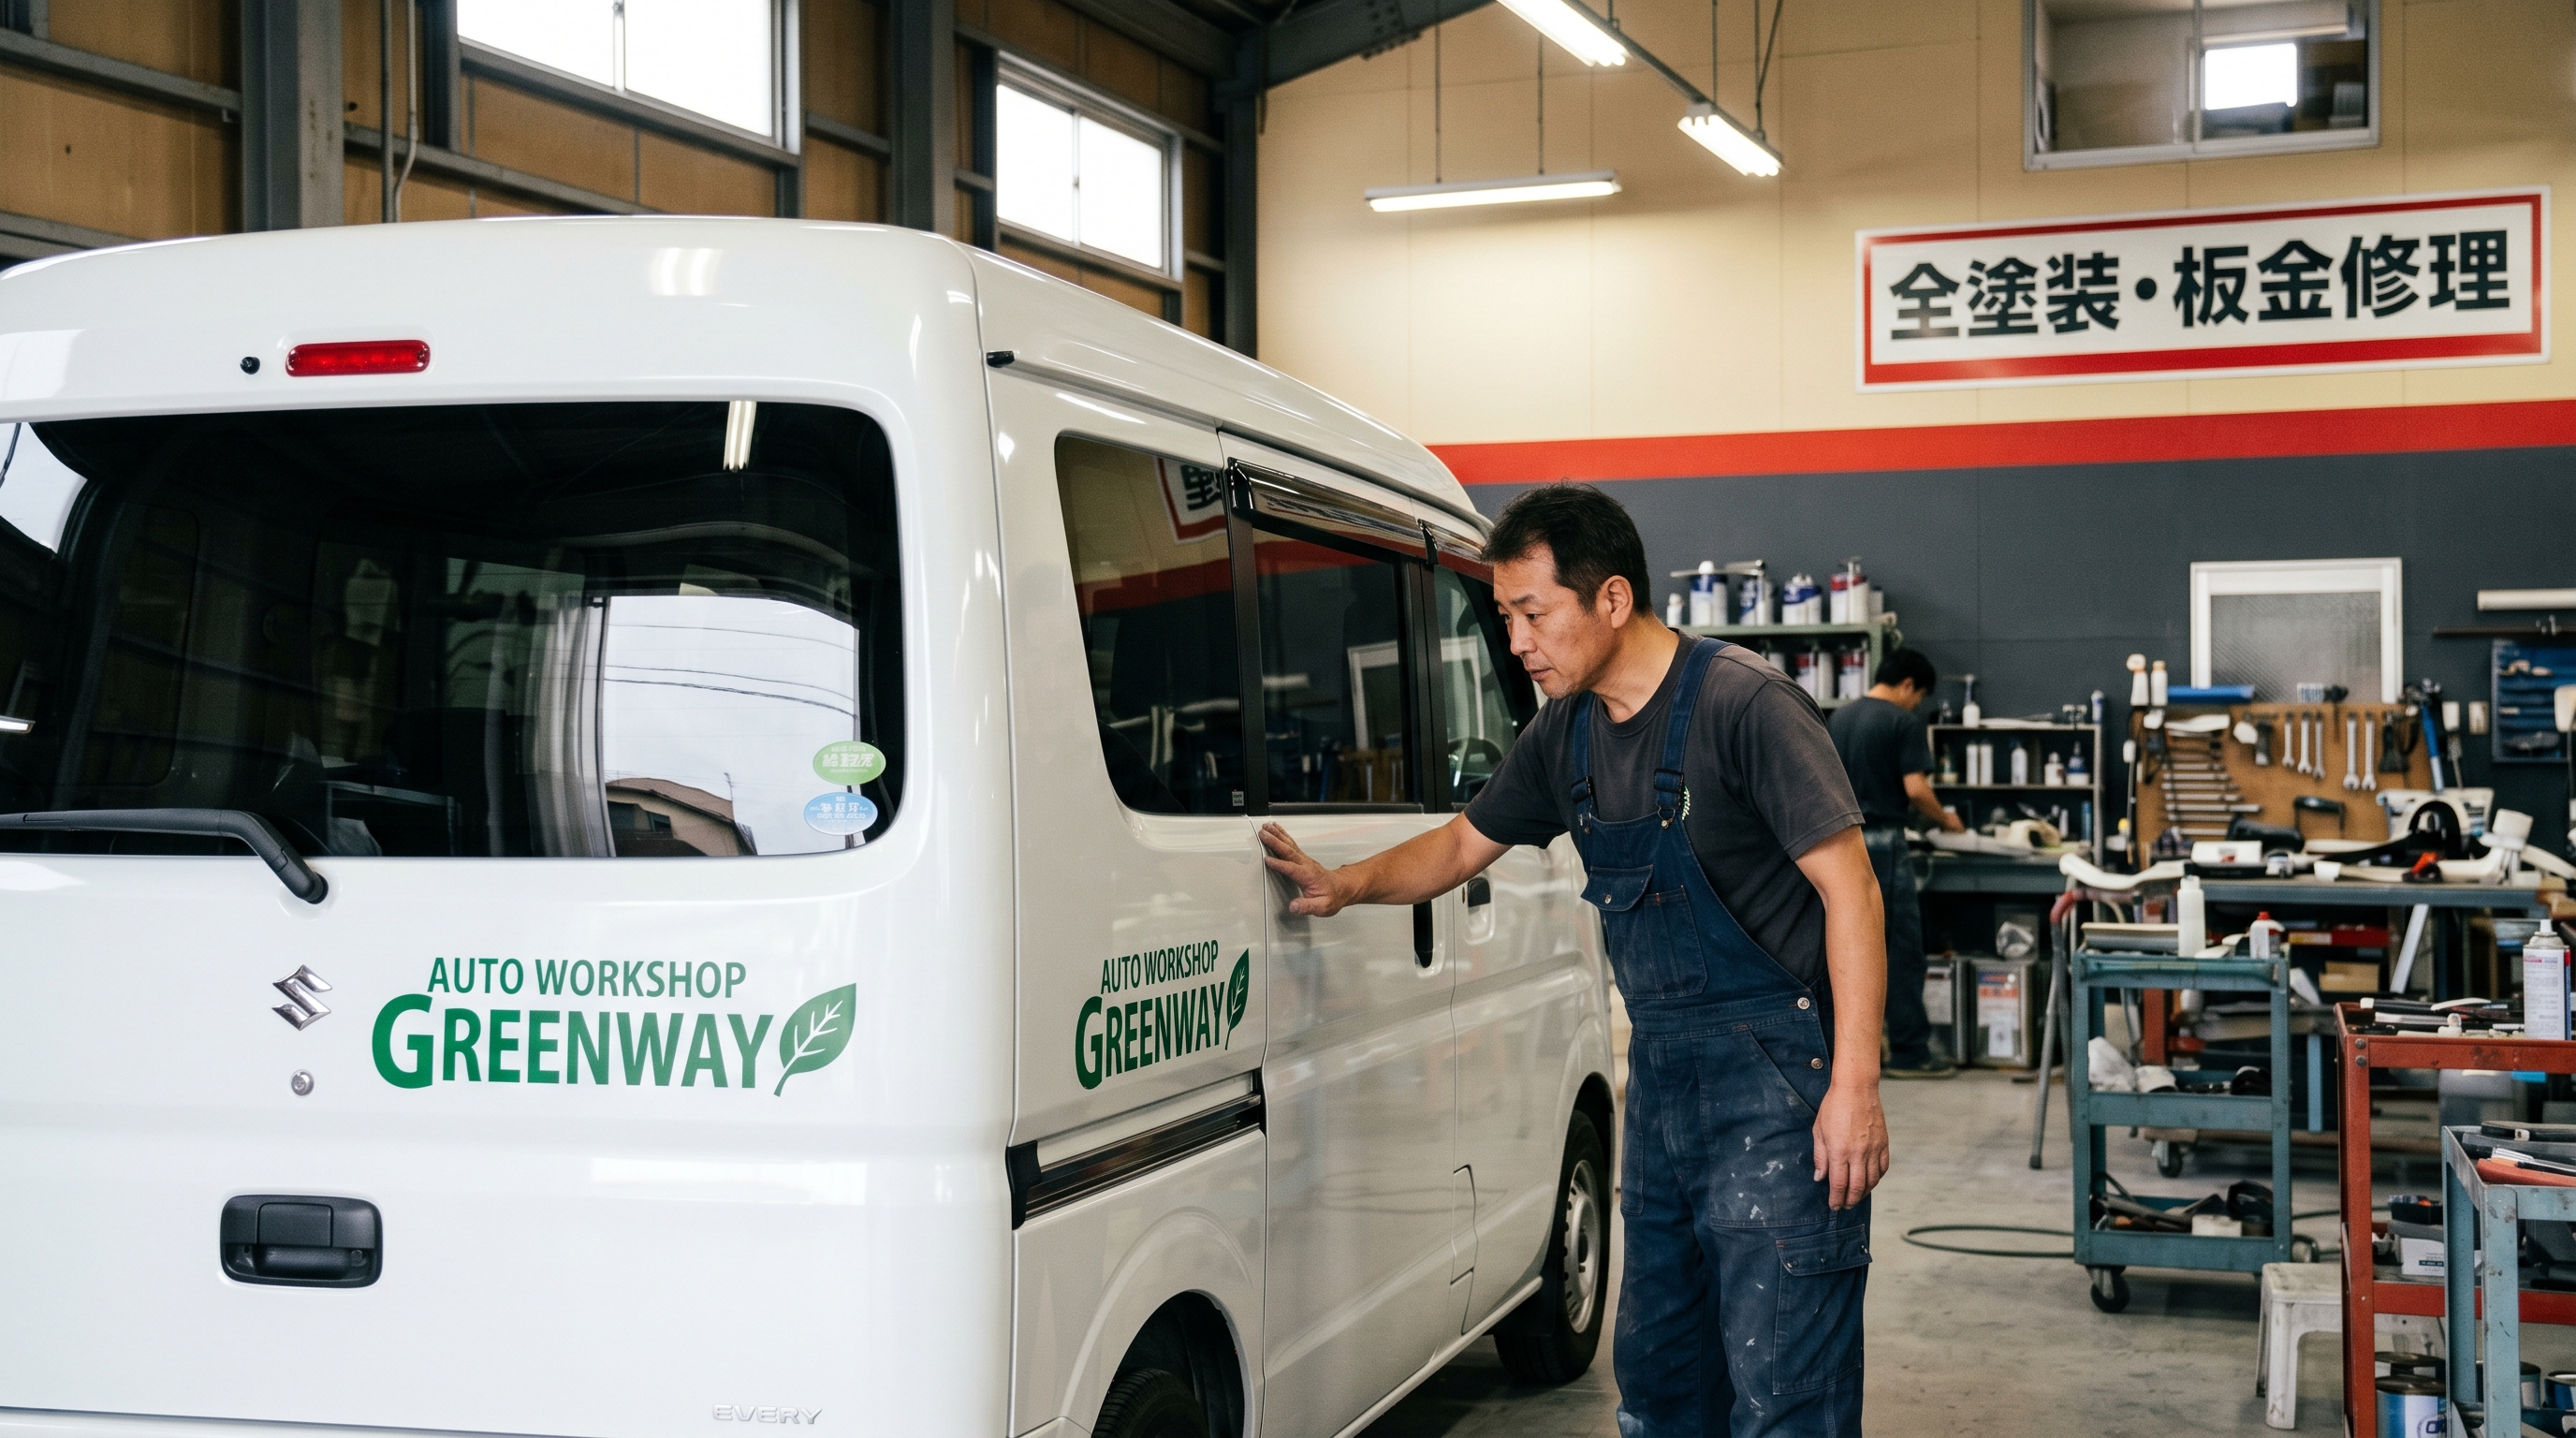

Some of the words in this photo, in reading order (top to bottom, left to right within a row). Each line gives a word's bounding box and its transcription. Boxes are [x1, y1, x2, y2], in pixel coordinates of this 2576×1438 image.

[1889, 229, 2510, 341] 全塗装・板金修理
[427, 957, 524, 994] AUTO
[534, 959, 747, 999] WORKSHOP
[1101, 954, 1141, 995] AUTO
[1144, 939, 1219, 986] WORKSHOP
[371, 992, 775, 1090] GREENWAY
[1075, 981, 1225, 1091] GREENWAY
[712, 1403, 823, 1425] EVERY
